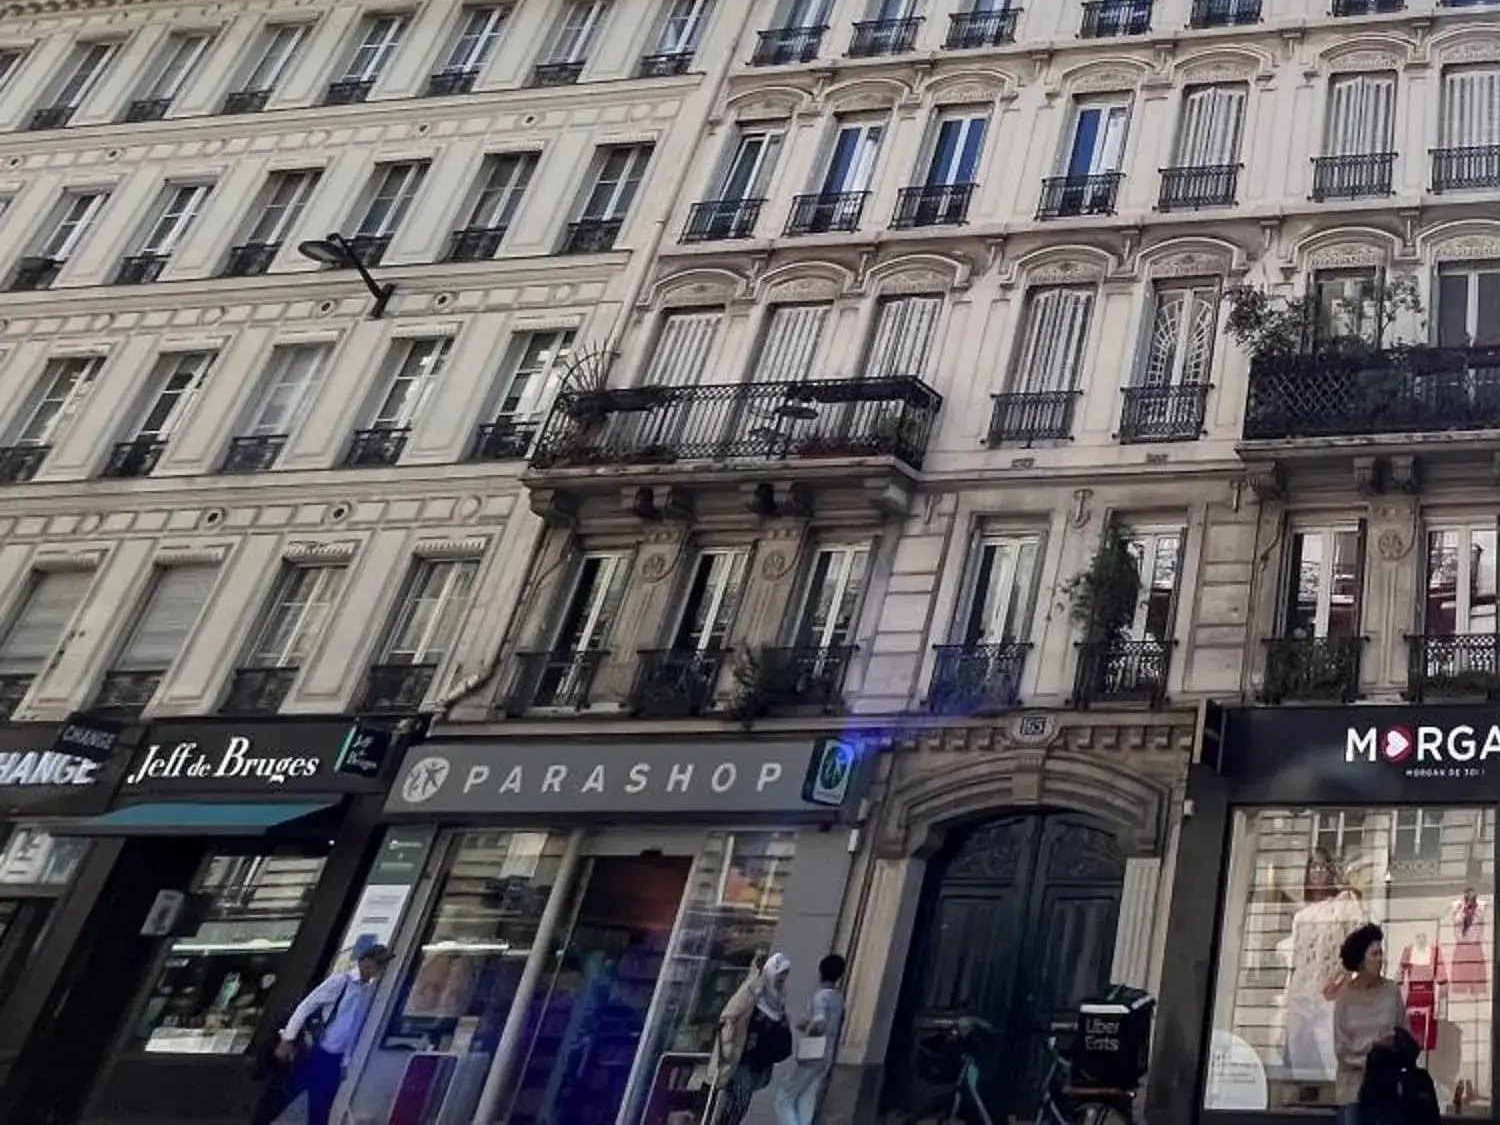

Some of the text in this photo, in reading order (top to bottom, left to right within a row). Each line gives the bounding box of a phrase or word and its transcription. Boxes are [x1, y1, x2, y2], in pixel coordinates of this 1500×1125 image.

[127, 736, 320, 783] Jeff de Bruges
[462, 763, 782, 794] PARASHOP
[1085, 1018, 1120, 1034] Uber
[1085, 1035, 1120, 1051] Eats
